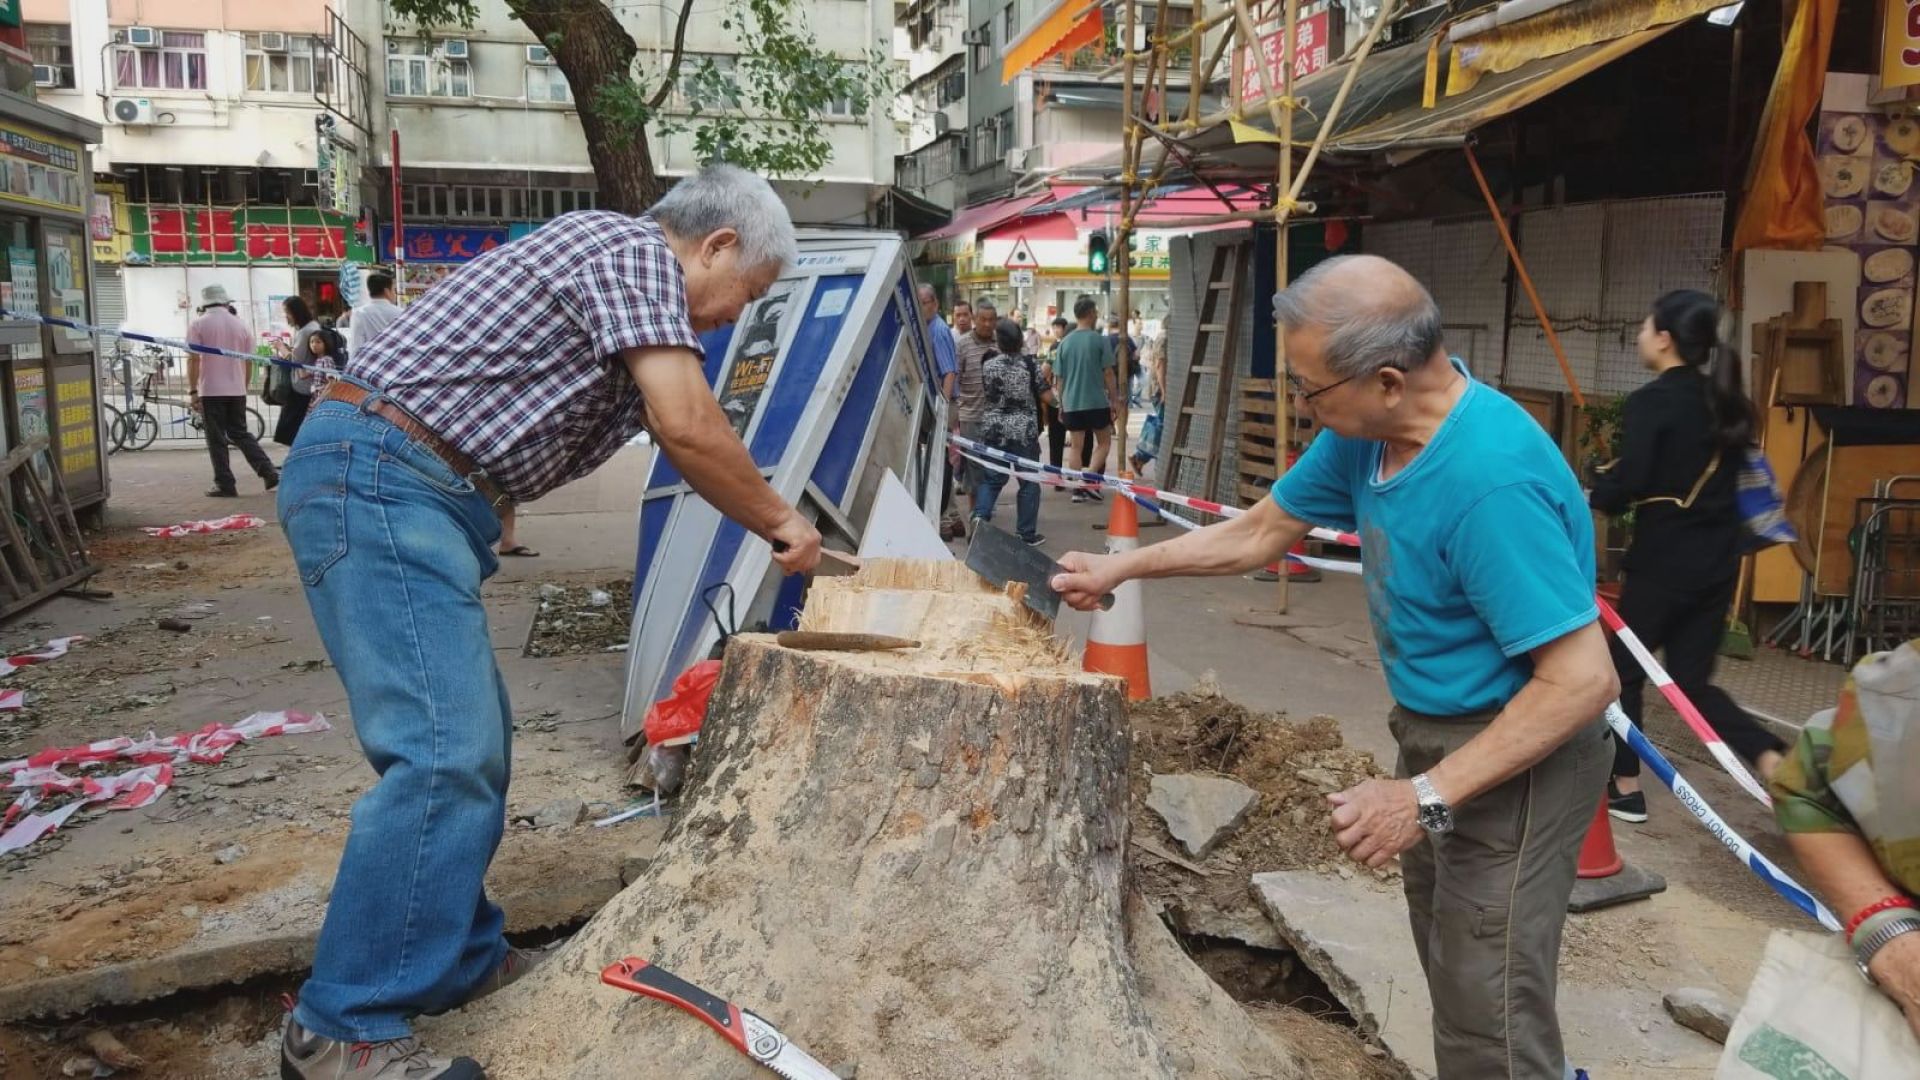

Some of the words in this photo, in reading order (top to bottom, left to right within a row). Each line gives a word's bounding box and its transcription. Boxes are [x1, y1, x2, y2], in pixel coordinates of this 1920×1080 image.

[1675, 785, 1707, 818] CROSS
[1707, 818, 1726, 838] NOT
[1725, 836, 1740, 854] DO
